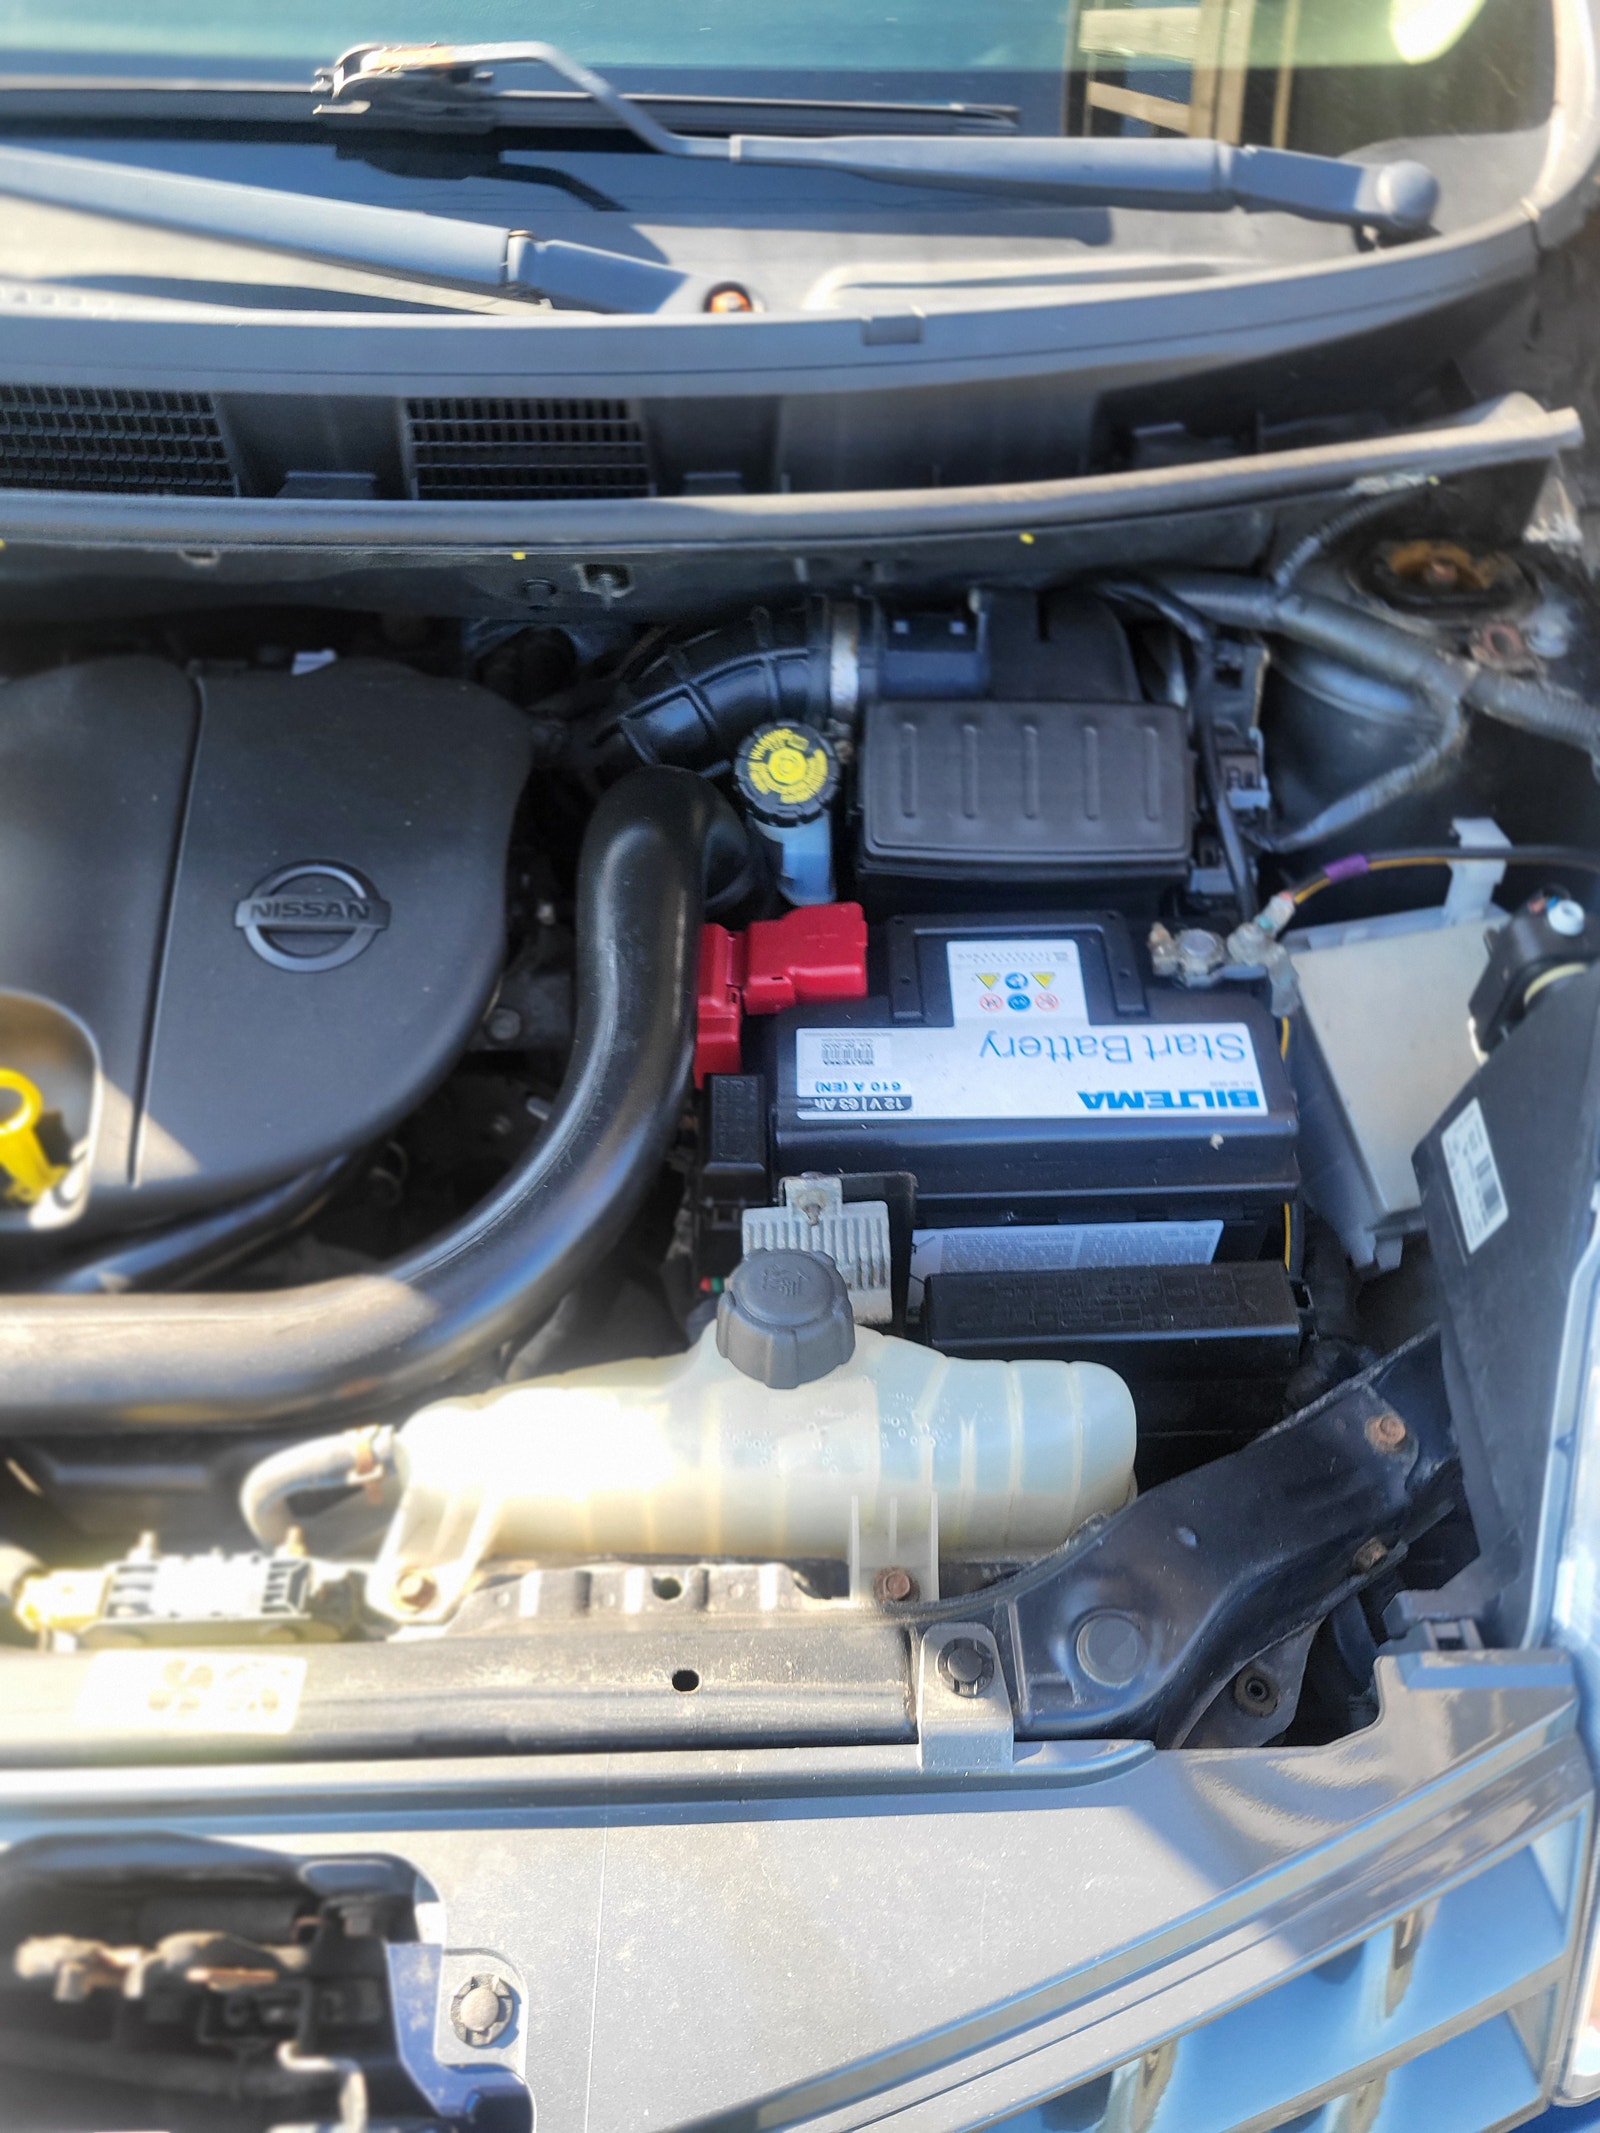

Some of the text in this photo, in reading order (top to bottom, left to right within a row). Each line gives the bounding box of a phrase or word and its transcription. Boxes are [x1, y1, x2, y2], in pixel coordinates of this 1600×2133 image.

[250, 901, 370, 920] NISSAN
[979, 1030, 1245, 1063] Start Battery
[814, 1081, 901, 1093] 610 A (EN)
[814, 1098, 837, 1111] Ah
[869, 1097, 883, 1110] V
[884, 1097, 905, 1110] 12
[1077, 1089, 1259, 1110] BILTEMA
